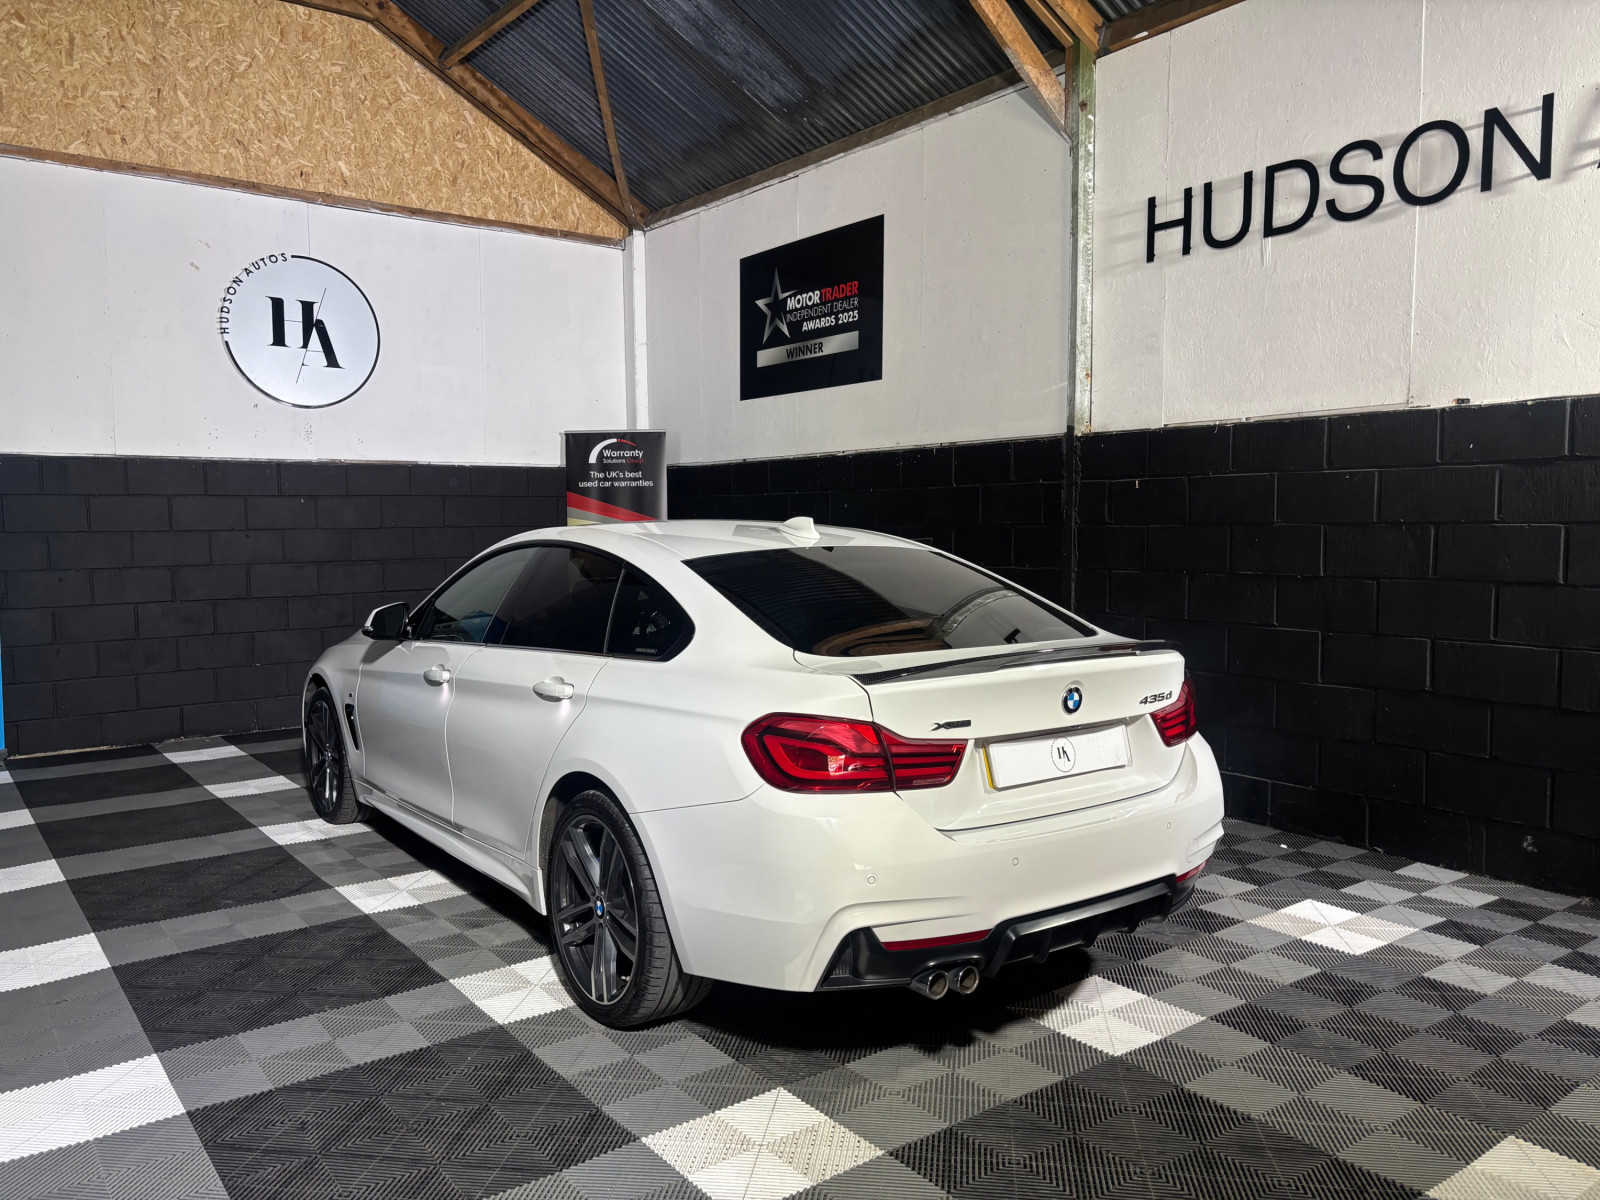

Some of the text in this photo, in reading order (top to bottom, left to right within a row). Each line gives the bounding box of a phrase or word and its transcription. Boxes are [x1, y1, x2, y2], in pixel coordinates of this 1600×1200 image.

[1146, 93, 1554, 263] HUDSON
[219, 276, 244, 335] HUDSON
[786, 281, 859, 311] MOTOR TRADER
[786, 297, 859, 323] INDEPENDENT DEALER
[802, 310, 859, 332] AWARDS 2025
[786, 341, 824, 359] WINNER
[602, 449, 644, 459] Warranty
[578, 480, 598, 488] used
[589, 471, 605, 479] The
[606, 471, 624, 479] UK's
[1139, 690, 1173, 705] 435d
